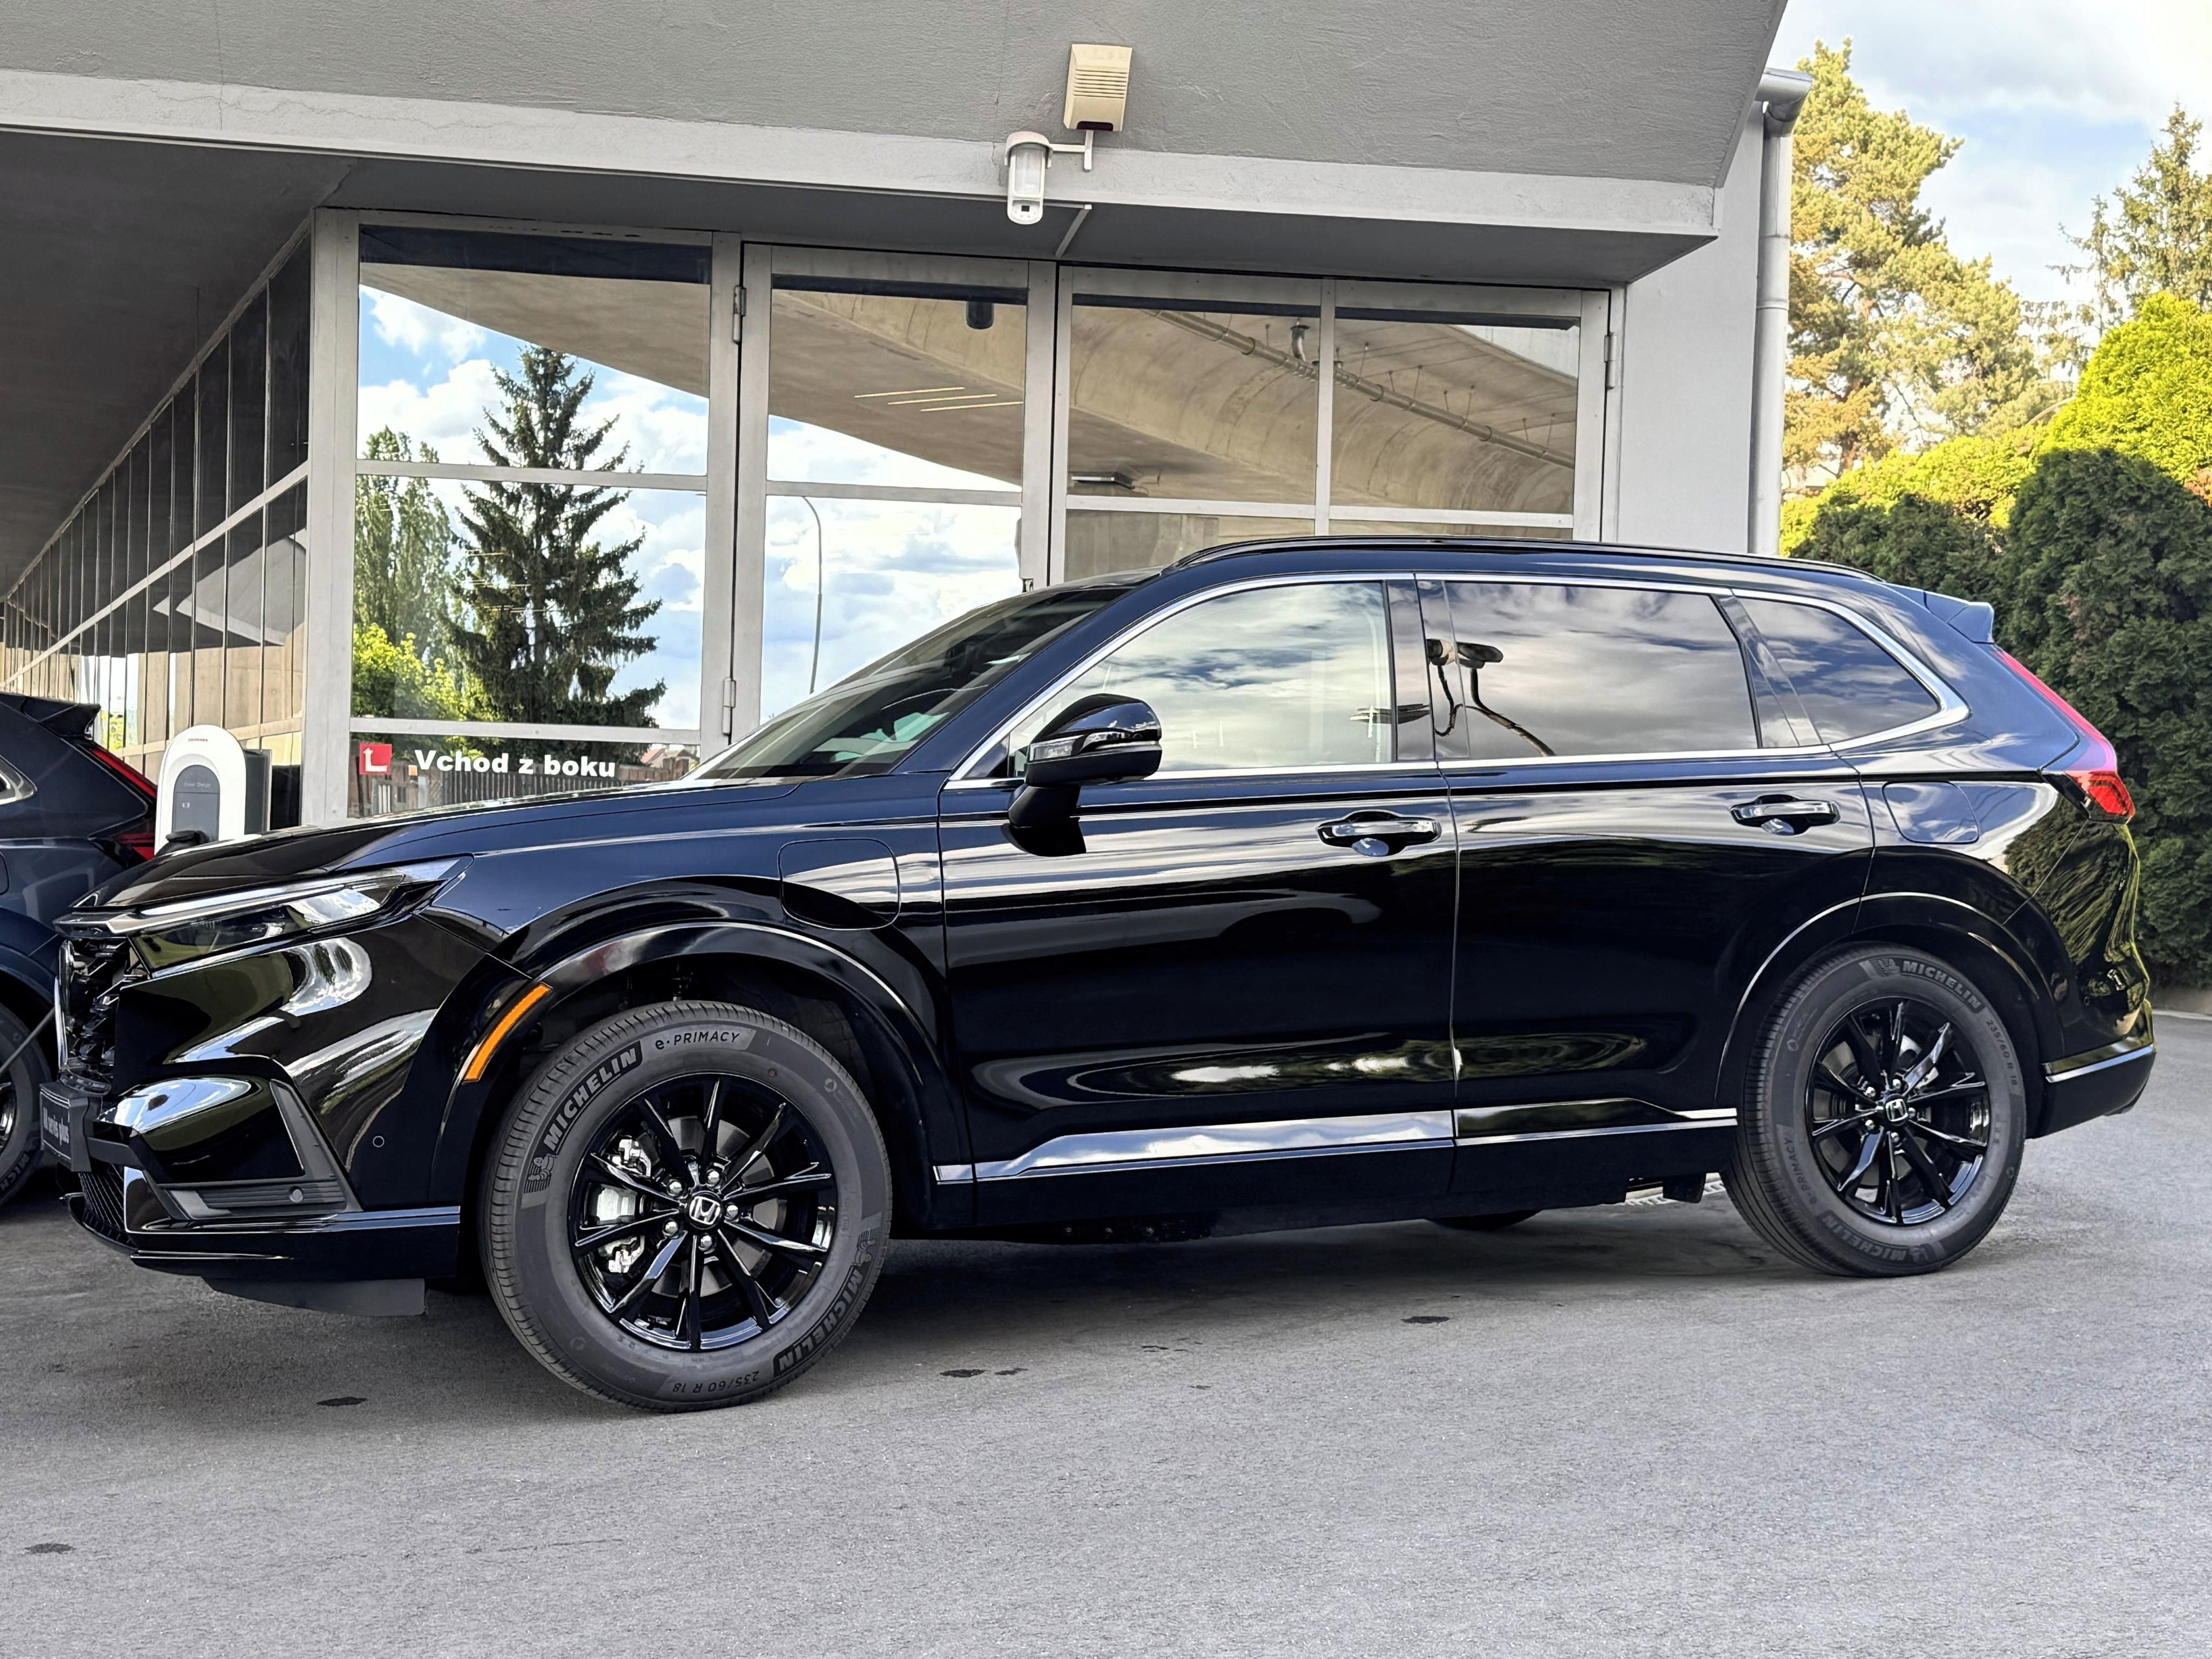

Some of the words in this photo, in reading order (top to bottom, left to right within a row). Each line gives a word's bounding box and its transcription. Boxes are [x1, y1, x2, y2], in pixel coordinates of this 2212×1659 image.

[415, 749, 509, 773] Vchod
[518, 758, 534, 774] z
[544, 754, 615, 777] boku
[1902, 960, 1982, 1008] MICHELIN
[1986, 1019, 2009, 1058] 235/60
[543, 1048, 637, 1151] MICHELIN
[1822, 1215, 1907, 1261] MICHELIN
[778, 1269, 865, 1373] MICHELIN
[672, 1383, 687, 1393] 18
[692, 1382, 703, 1394] R
[708, 1370, 759, 1393] 235/60
